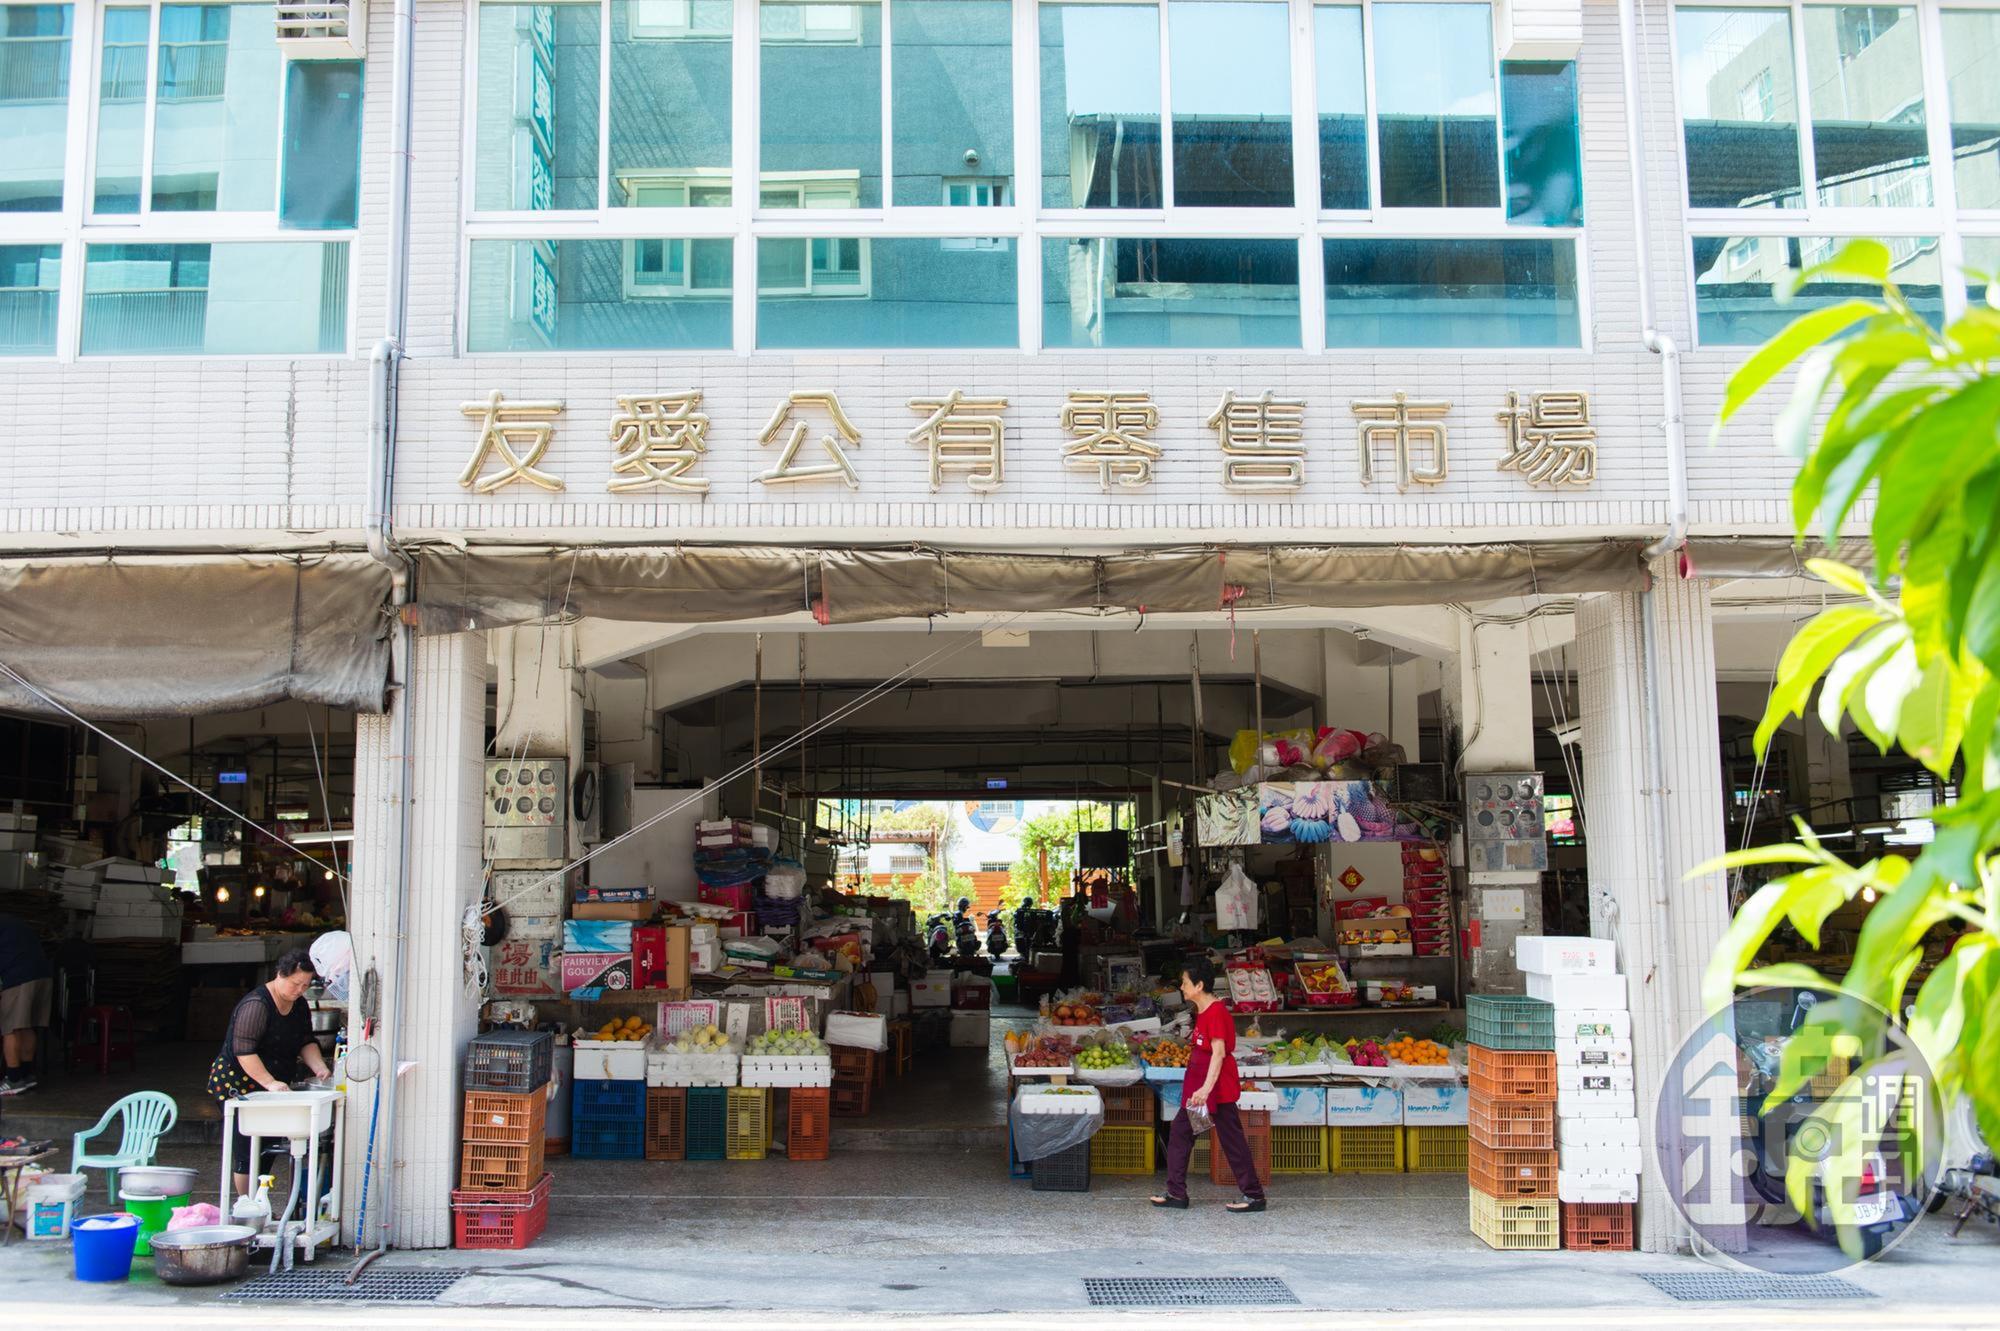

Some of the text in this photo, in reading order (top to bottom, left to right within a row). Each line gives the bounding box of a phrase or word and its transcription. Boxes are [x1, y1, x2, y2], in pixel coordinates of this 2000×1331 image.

[458, 387, 1598, 493] 友愛公有零售市場
[564, 957, 610, 967] FAIRVIEW
[567, 967, 595, 976] GOLD
[1589, 1078, 1605, 1089] MC
